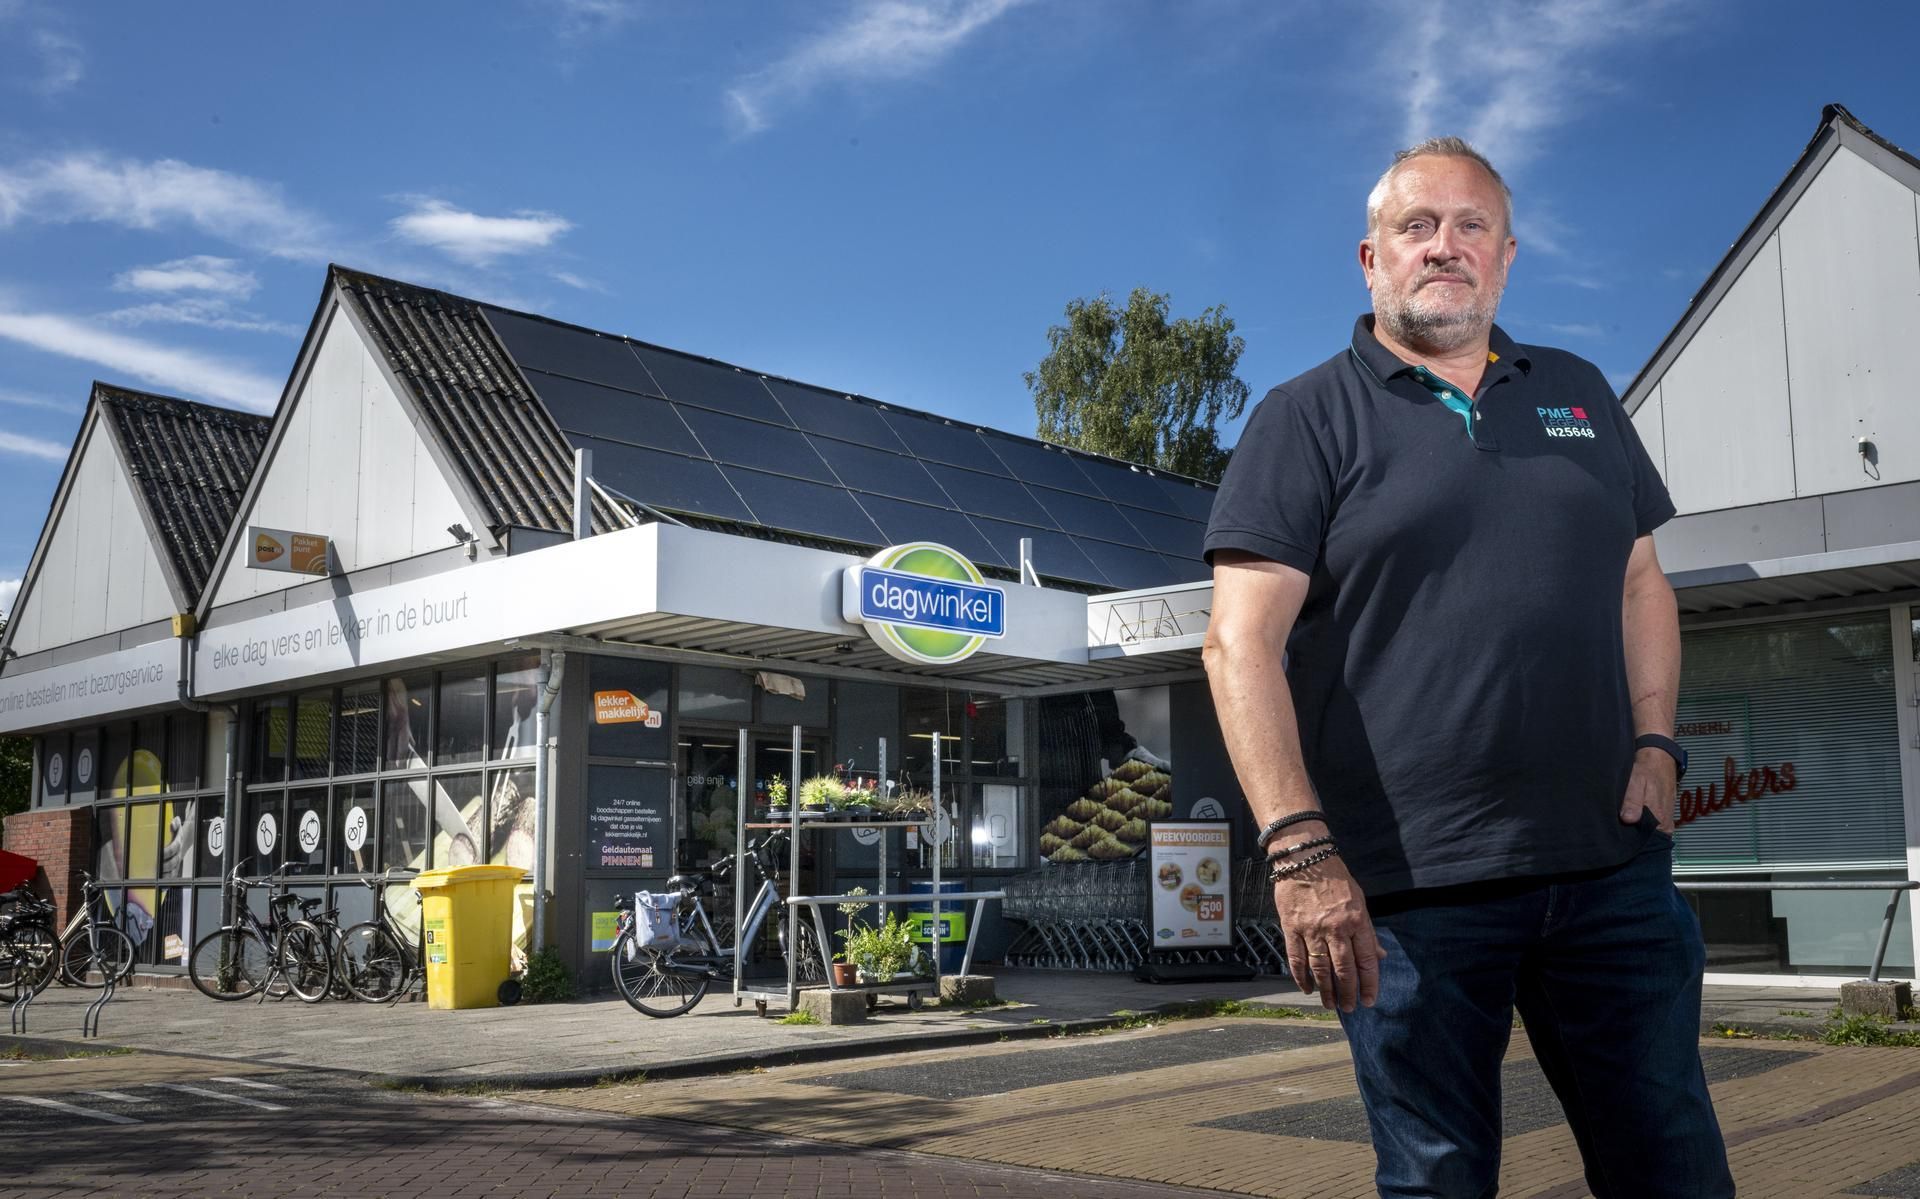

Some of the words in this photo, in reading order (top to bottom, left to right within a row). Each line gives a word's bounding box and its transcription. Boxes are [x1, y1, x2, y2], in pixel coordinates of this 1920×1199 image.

[1537, 407, 1574, 418] PME
[1542, 418, 1590, 428] LEGEND
[1546, 427, 1595, 438] N25648
[294, 536, 318, 546] Pakket
[872, 577, 992, 623] dagwinkel
[213, 643, 239, 670] elke
[242, 638, 267, 666] dag
[272, 633, 300, 656] vers
[305, 628, 322, 650] en
[327, 615, 372, 646] lekker
[377, 609, 390, 635] in
[396, 603, 417, 631] de
[422, 592, 468, 626] buurt
[0, 690, 24, 713] online
[26, 681, 67, 708] bestellen
[68, 678, 88, 698] met
[90, 661, 163, 695] bezorgservice
[598, 695, 630, 707] lekker
[599, 705, 647, 719] makkelijk
[646, 714, 660, 725] .nl
[1675, 721, 1731, 736] AGERIJ
[1675, 756, 1796, 828] eukers
[1153, 832, 1226, 842] WEEKVOORDEEL
[602, 845, 652, 854] Geldautomaat
[601, 855, 641, 866] PINNEN
[923, 927, 946, 935] SCON
